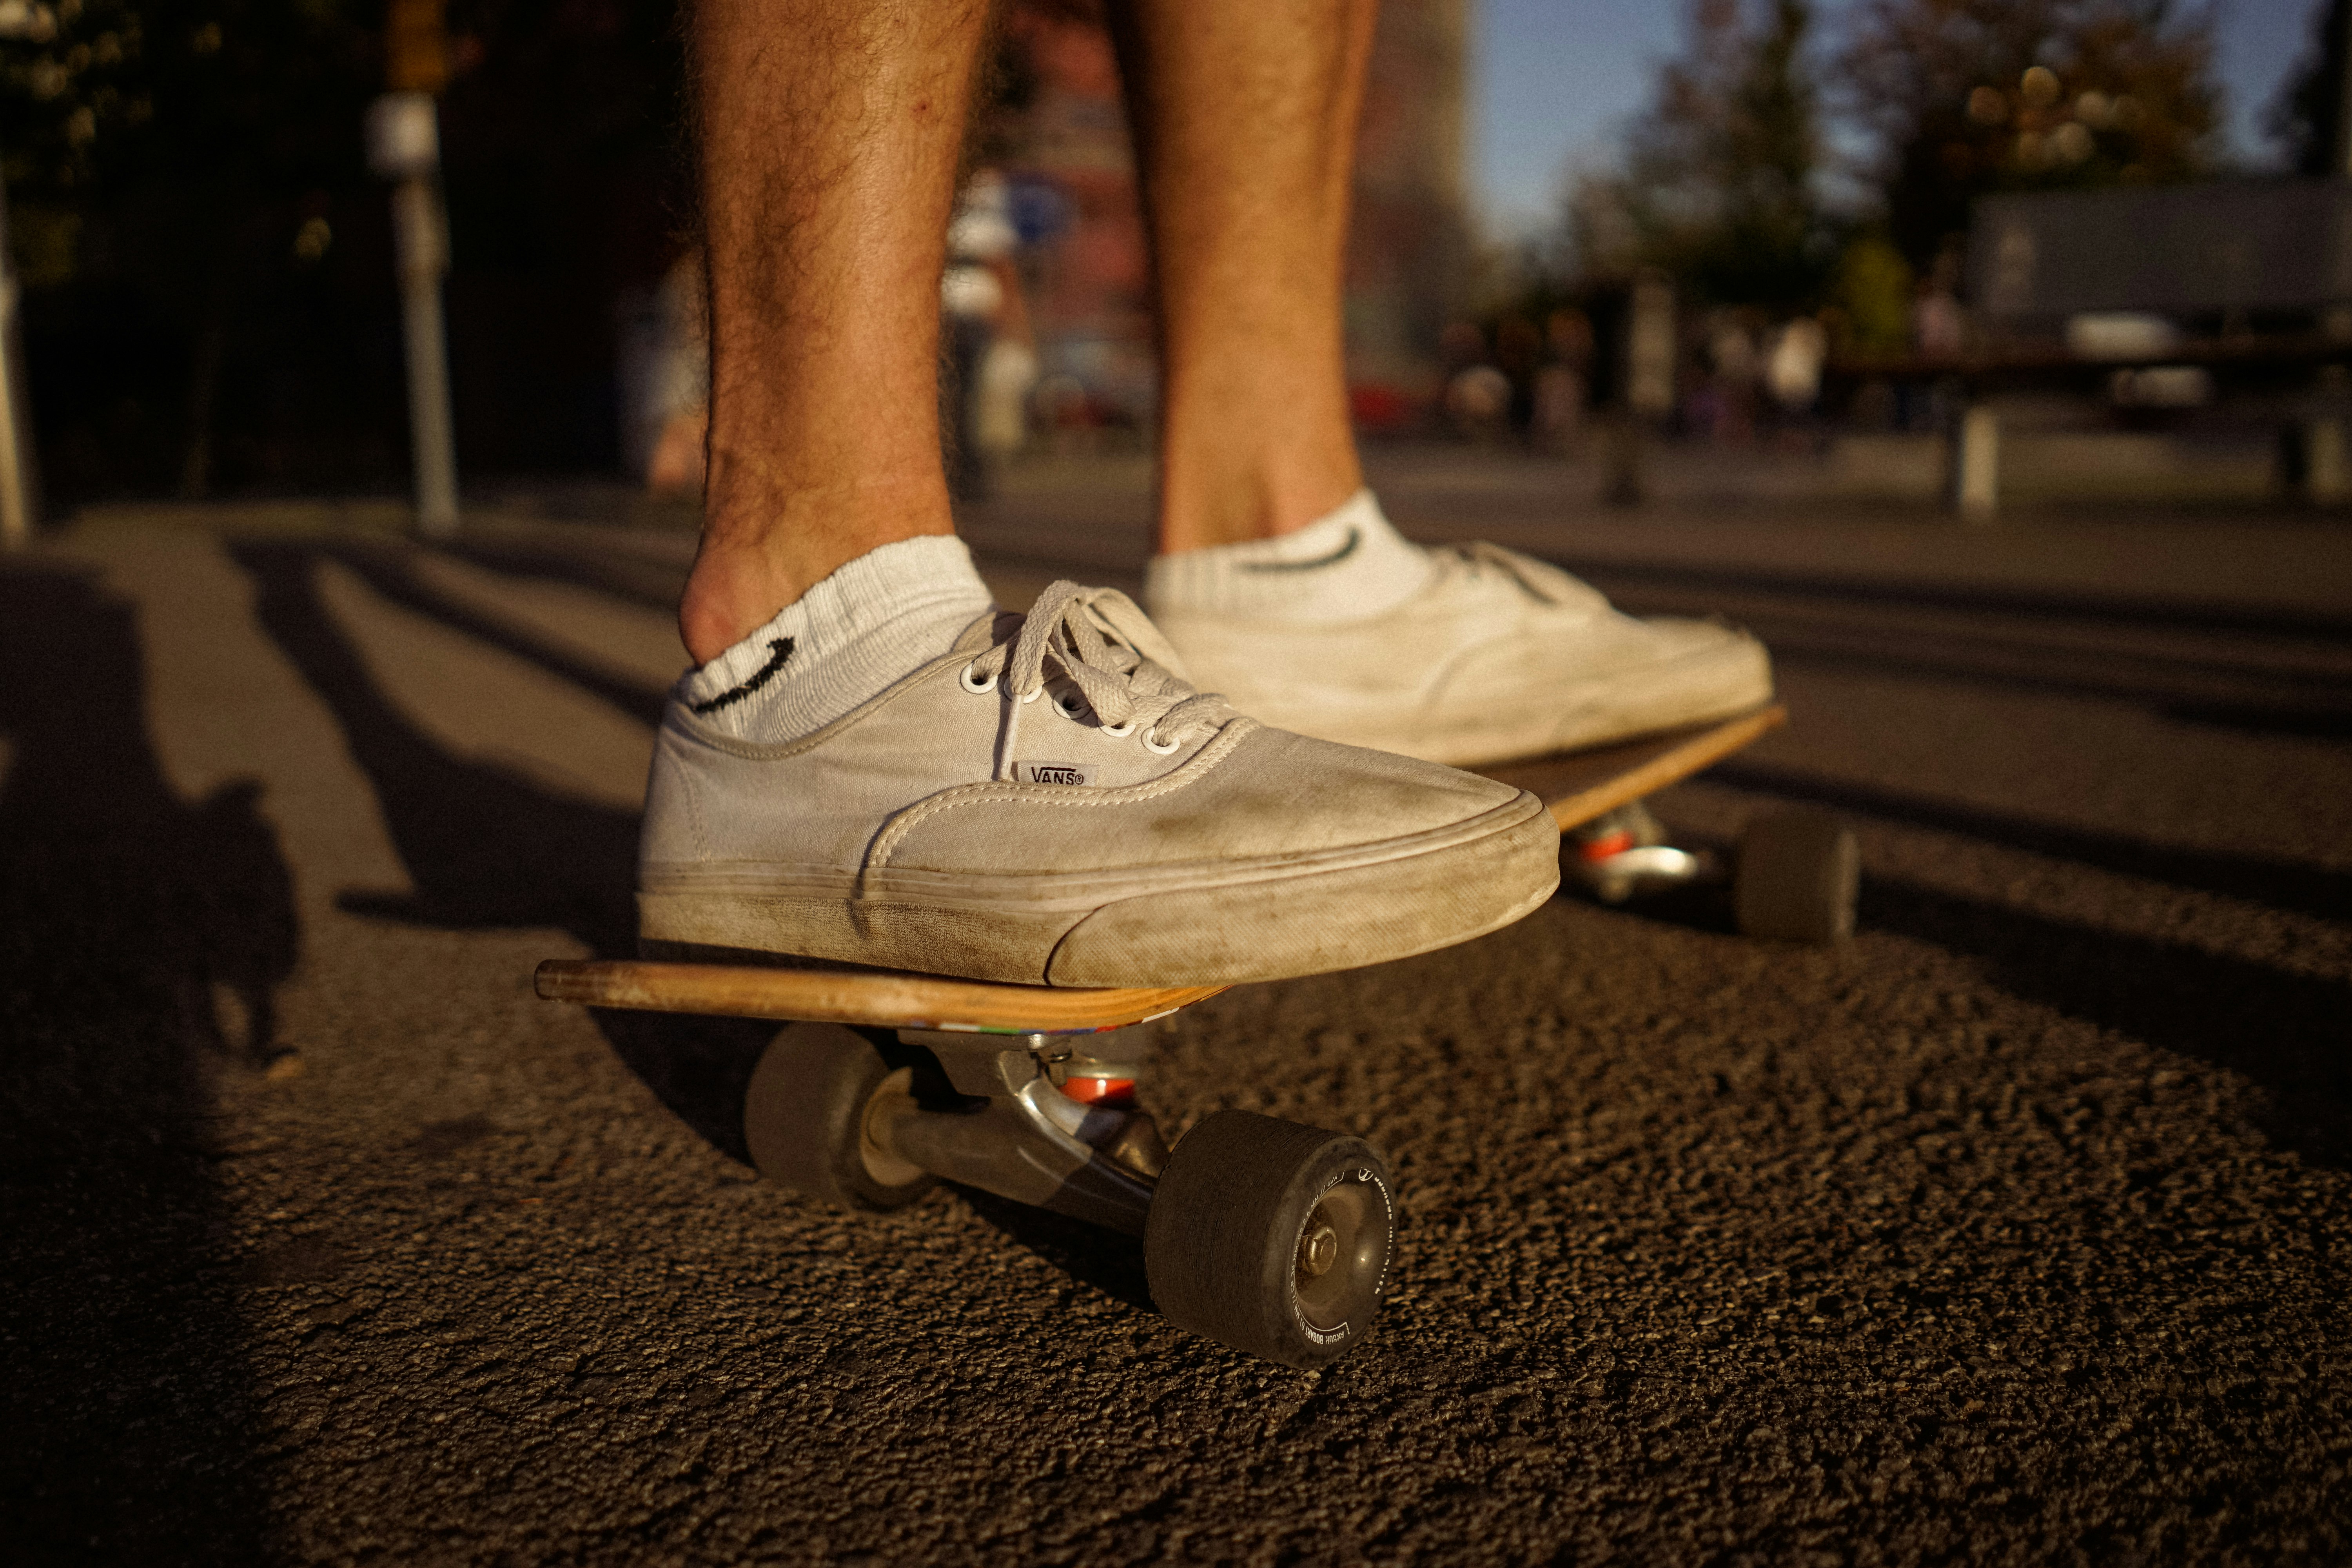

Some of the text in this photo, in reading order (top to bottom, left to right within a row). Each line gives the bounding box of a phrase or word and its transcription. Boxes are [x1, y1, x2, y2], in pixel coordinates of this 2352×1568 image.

[1294, 1303, 1300, 1320] MM
[1299, 1316, 1305, 1330] 61
[1305, 1325, 1323, 1345] BOGART
